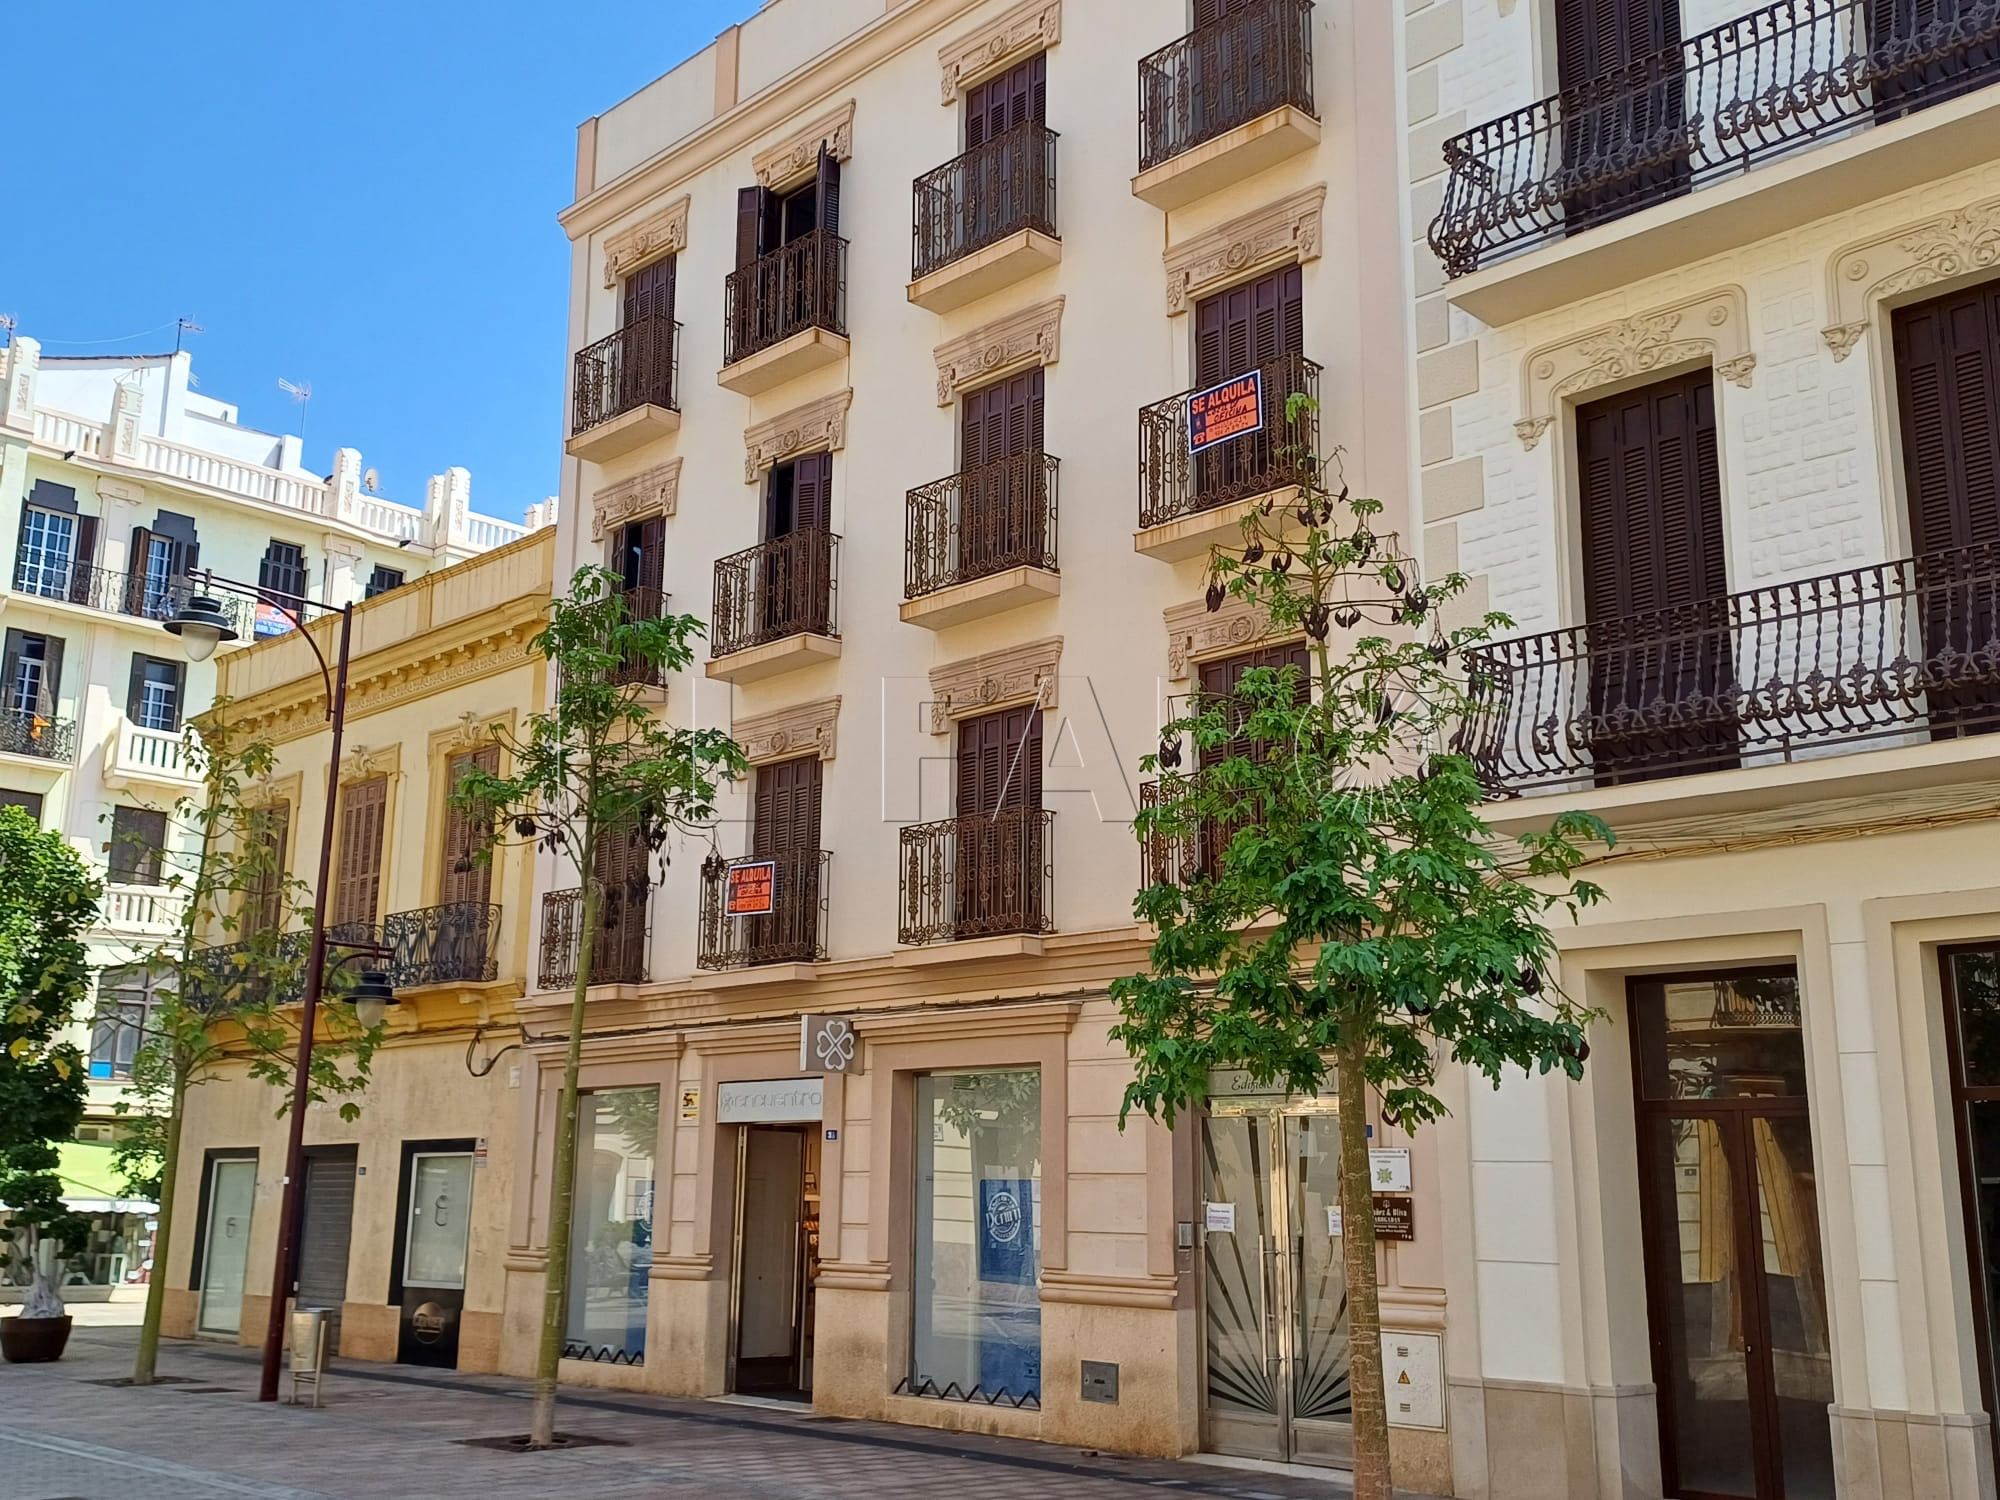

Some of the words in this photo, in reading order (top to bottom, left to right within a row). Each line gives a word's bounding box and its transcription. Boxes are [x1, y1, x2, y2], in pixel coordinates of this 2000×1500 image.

[1192, 397, 1206, 415] SE
[1207, 377, 1256, 409] ALQUILA
[730, 870, 741, 884] SE
[741, 866, 771, 883] ALQUILA
